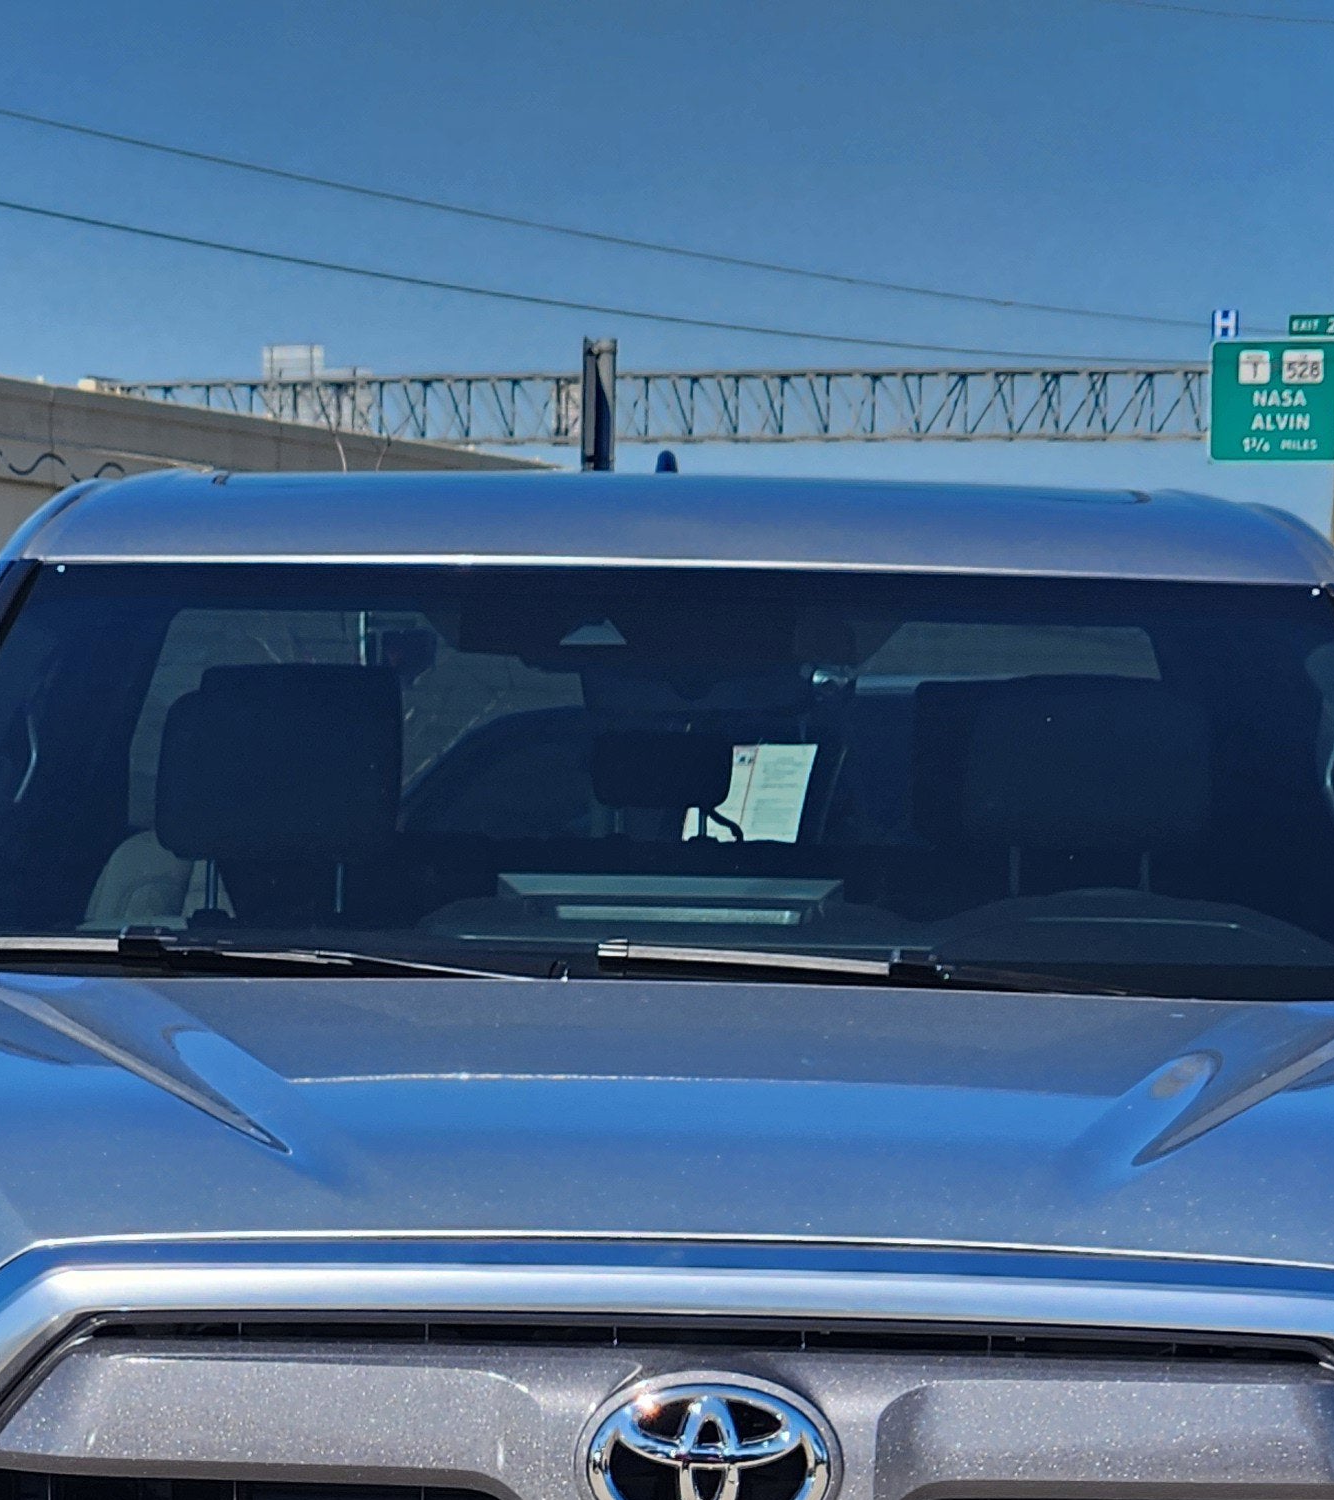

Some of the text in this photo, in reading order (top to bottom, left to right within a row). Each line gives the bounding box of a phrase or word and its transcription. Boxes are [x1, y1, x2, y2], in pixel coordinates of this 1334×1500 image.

[1291, 318, 1319, 331] EXIT
[1287, 360, 1321, 379] 528
[1252, 389, 1307, 407] NASA
[1251, 413, 1311, 431] ALVIN
[1280, 438, 1319, 451] MILES
